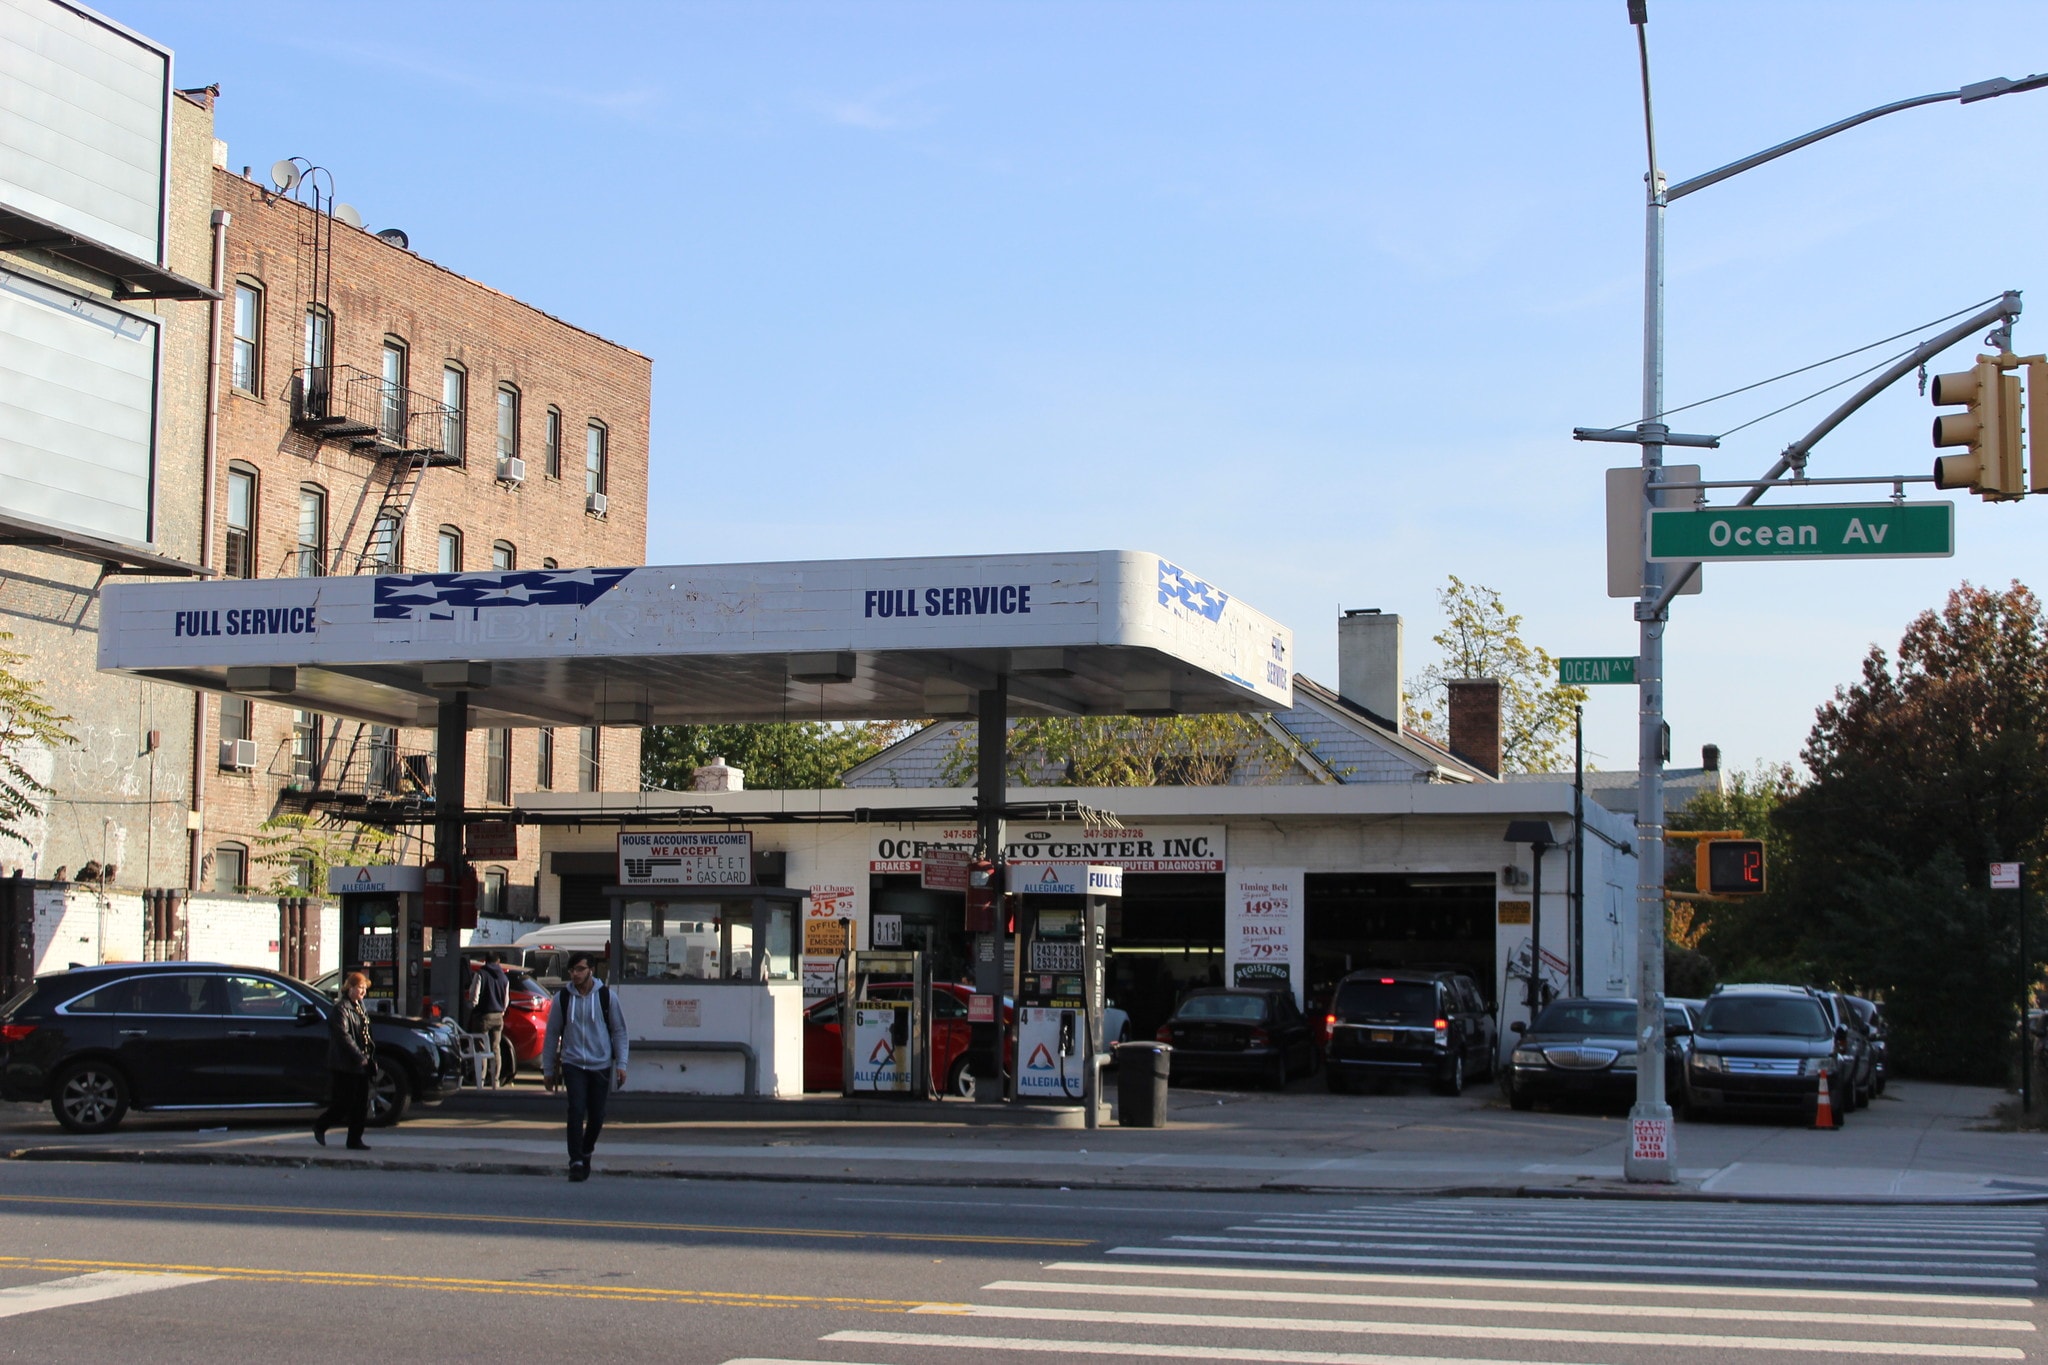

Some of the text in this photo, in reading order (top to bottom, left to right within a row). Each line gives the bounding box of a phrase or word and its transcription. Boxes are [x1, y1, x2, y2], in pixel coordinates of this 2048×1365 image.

[1709, 517, 1889, 547] Ocean Av
[864, 585, 1031, 618] FULL SERVICE
[175, 607, 316, 637] FULL SERVICE
[1565, 660, 1631, 681] OCEAN AV
[1029, 832, 1047, 840] 1981
[1083, 829, 1144, 839] 347-587-5726
[622, 835, 747, 846] HOUSE ACCOUNTS WELCOME!
[651, 846, 719, 856] WE ACCEPT
[1048, 840, 1155, 858] CENTER
[1162, 837, 1215, 858] INC.
[697, 857, 745, 870] FLEET
[874, 861, 911, 871] BRAKES
[1158, 860, 1217, 871] DIAGNOSTIC
[1743, 851, 1760, 882] 12
[697, 871, 746, 883] GAS CARD
[1089, 872, 1113, 888] FULL
[342, 882, 386, 892] ALLEGIANCE
[809, 884, 854, 894] Oil Change
[1024, 883, 1075, 894] ALLEGIANCE
[1240, 883, 1288, 892] Timing Belt
[810, 900, 837, 917] 25
[838, 901, 853, 909] 95
[1245, 901, 1288, 914] 149 95
[1242, 926, 1286, 935] BRAKE
[362, 937, 388, 948] 243 273
[1036, 945, 1051, 957] 243
[1053, 945, 1067, 957] 273
[1251, 944, 1272, 957] 79
[1273, 944, 1288, 952] 95
[1036, 957, 1051, 969] 253
[1236, 963, 1287, 978] REGISTERED
[856, 1002, 894, 1010] DIESEL
[856, 1011, 864, 1026] 6
[1020, 1009, 1028, 1025] 4
[854, 1071, 911, 1083] ALLEGIANCE
[1637, 1135, 1663, 1143] (917)
